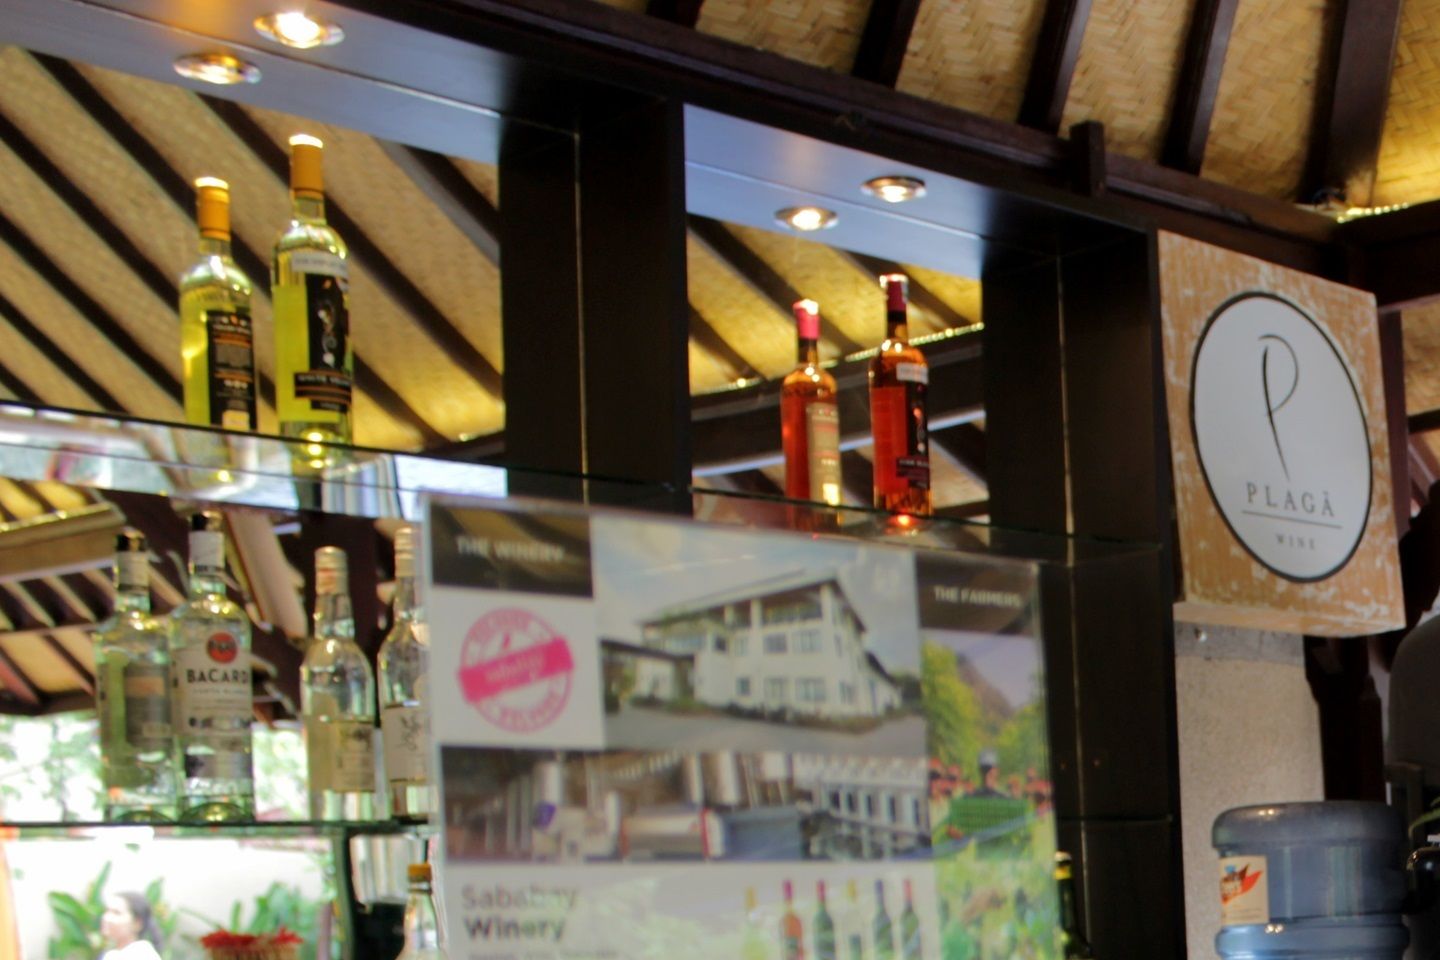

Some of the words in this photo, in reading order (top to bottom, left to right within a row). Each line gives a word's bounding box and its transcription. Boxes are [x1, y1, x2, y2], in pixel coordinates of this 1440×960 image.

[456, 535, 491, 555] THE
[494, 539, 565, 562] WINERY
[1275, 533, 1316, 551] WINE
[933, 584, 959, 603] THE
[961, 587, 1022, 609] FARMERS
[465, 913, 565, 943] Winery
